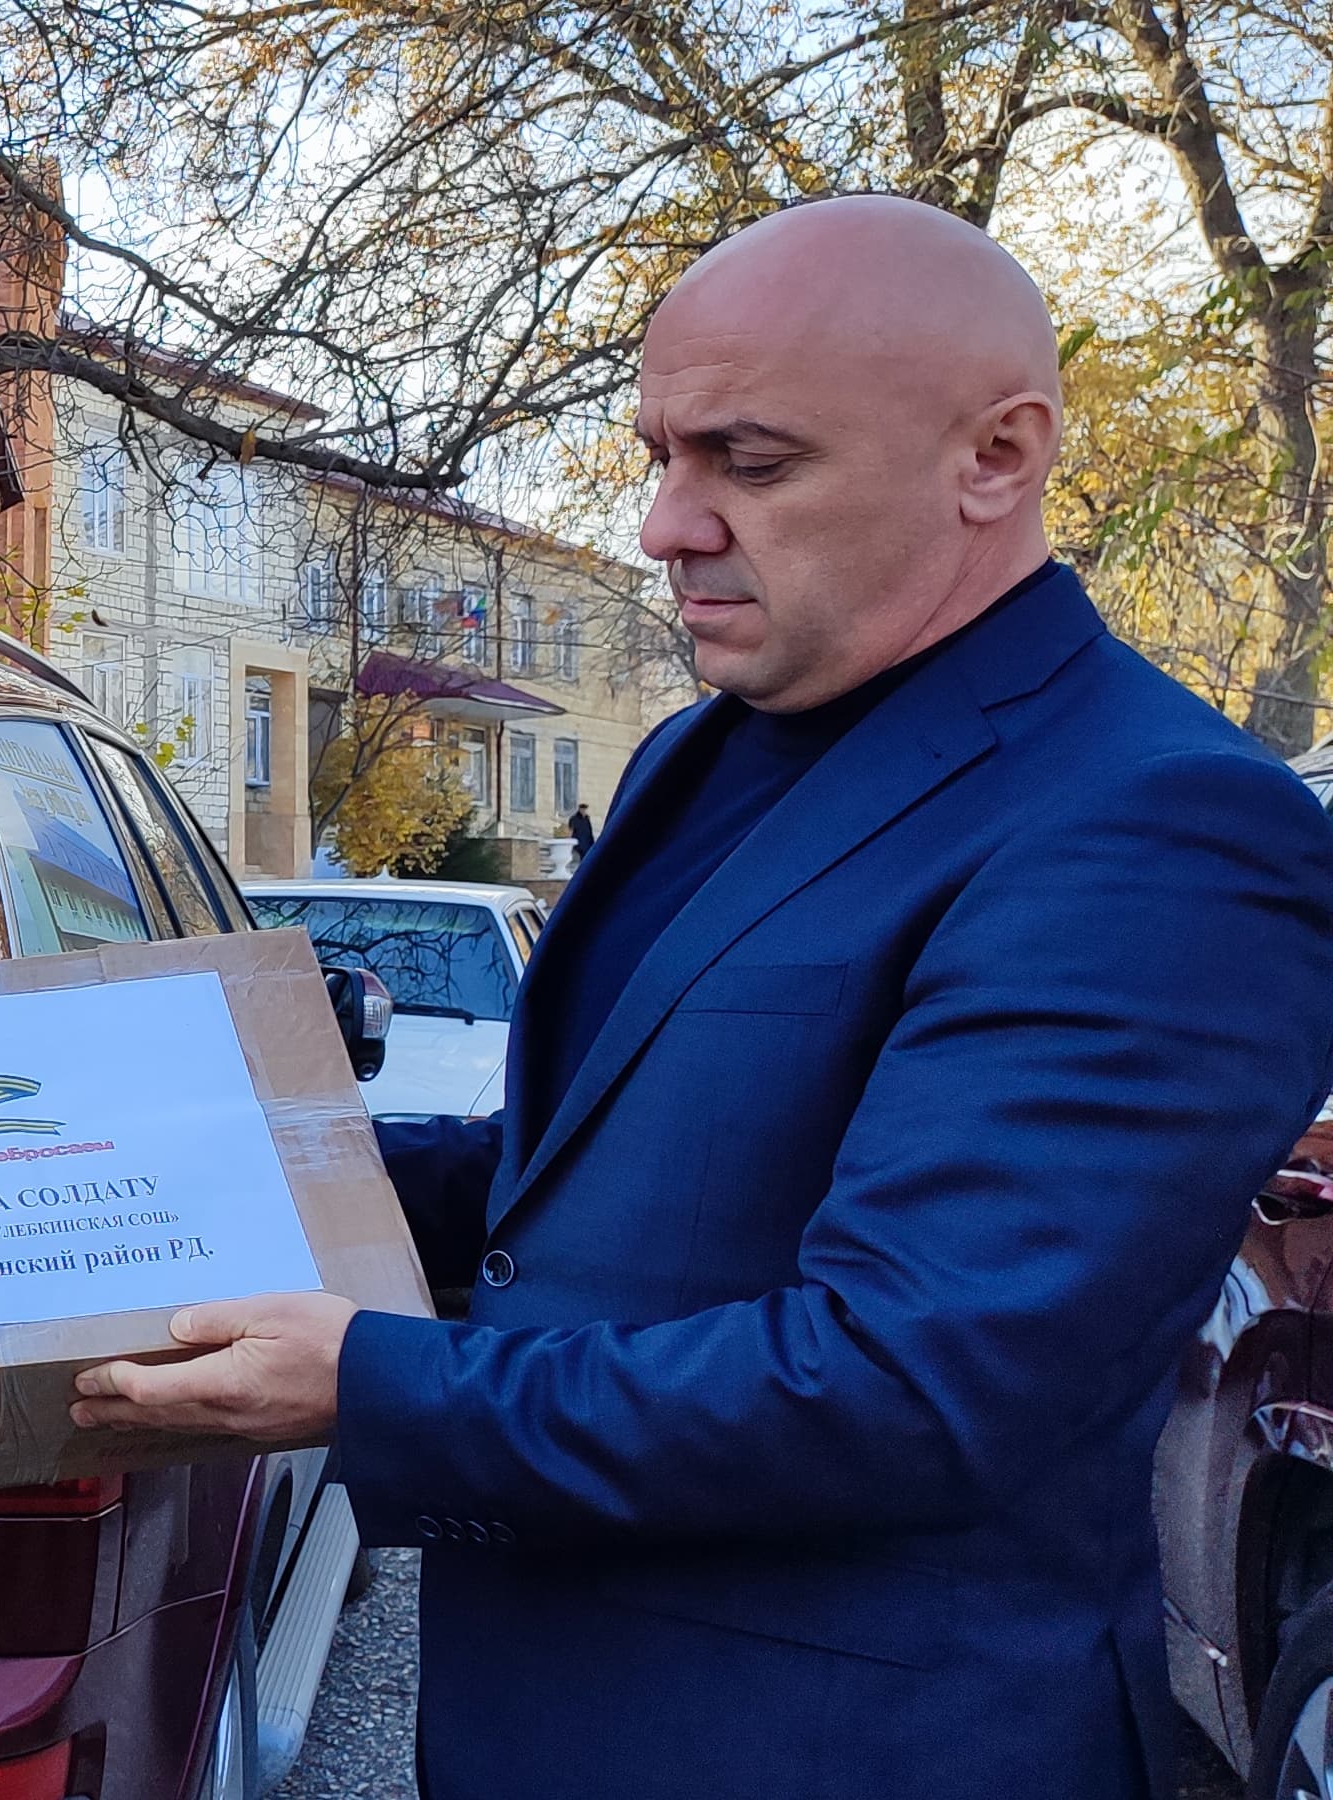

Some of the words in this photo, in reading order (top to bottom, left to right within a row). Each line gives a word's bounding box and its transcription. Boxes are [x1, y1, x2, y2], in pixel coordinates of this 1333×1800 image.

[17, 1175, 161, 1210] СОЛДАТУ
[128, 1209, 181, 1231] СОШ»
[84, 1245, 163, 1275] район
[168, 1236, 215, 1264] РД.
